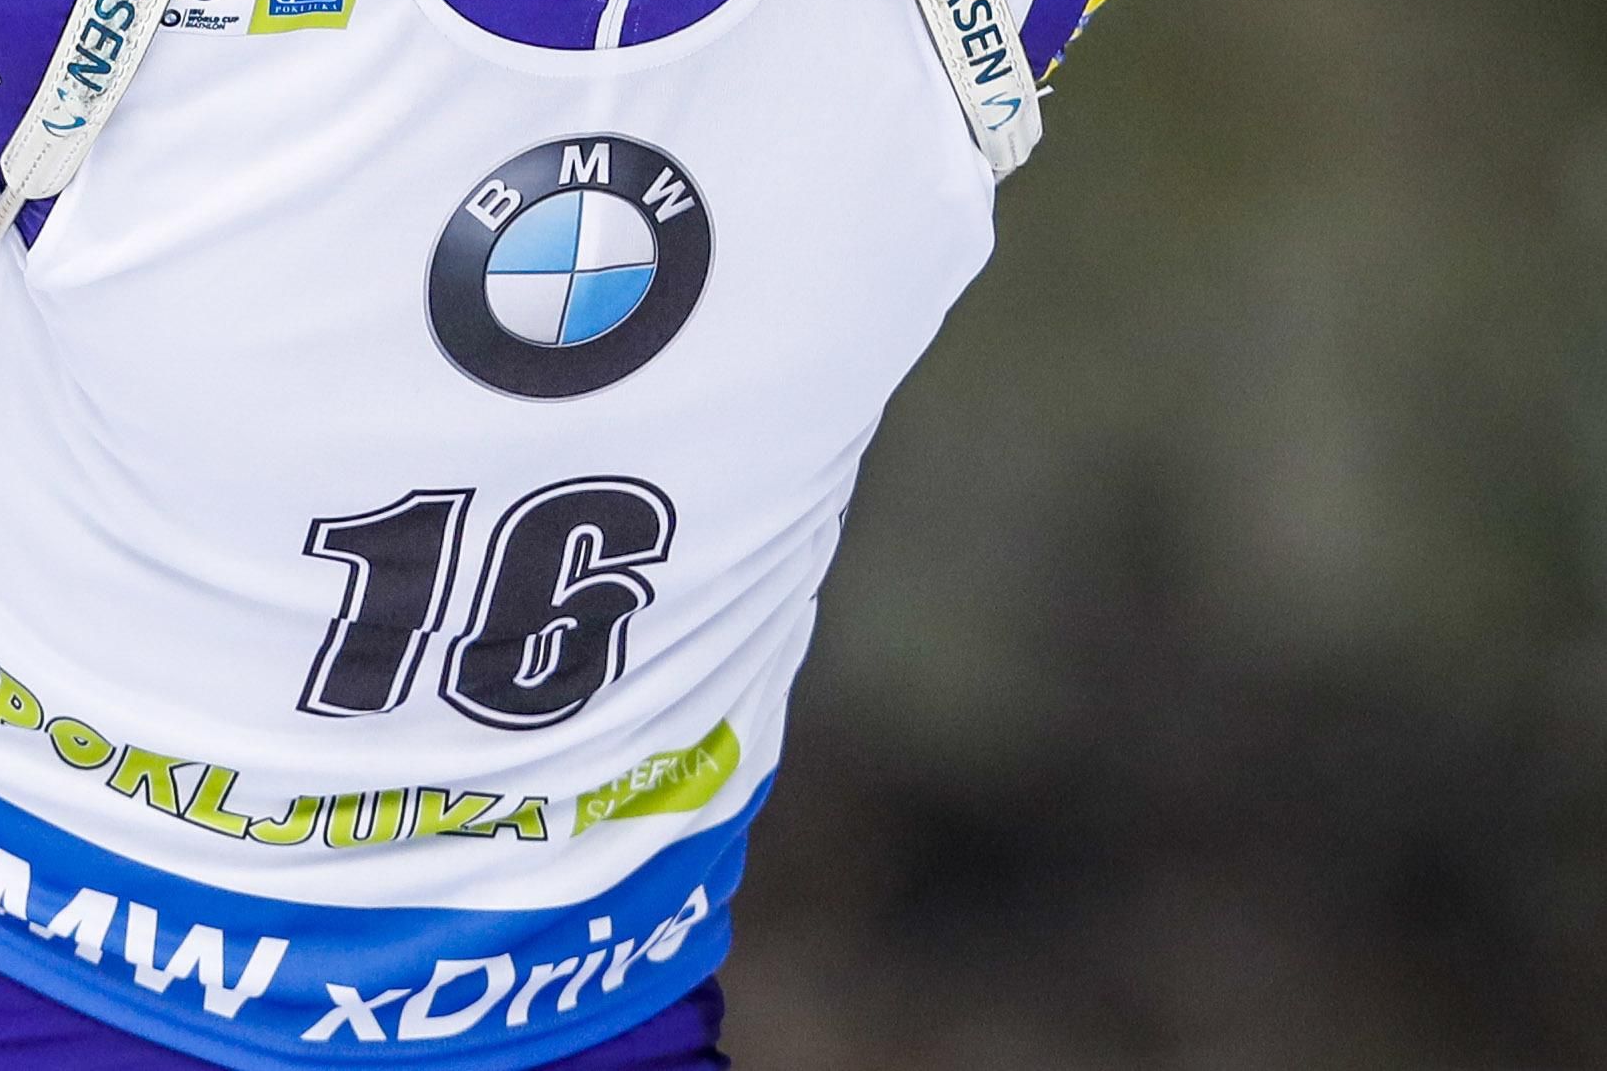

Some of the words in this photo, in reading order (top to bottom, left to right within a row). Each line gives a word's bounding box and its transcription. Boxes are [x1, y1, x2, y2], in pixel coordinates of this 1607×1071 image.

[188, 15, 220, 23] WORLD
[221, 15, 240, 23] CUP
[465, 141, 696, 232] BMW
[296, 474, 678, 732] 16
[300, 883, 710, 1042] xDrive
